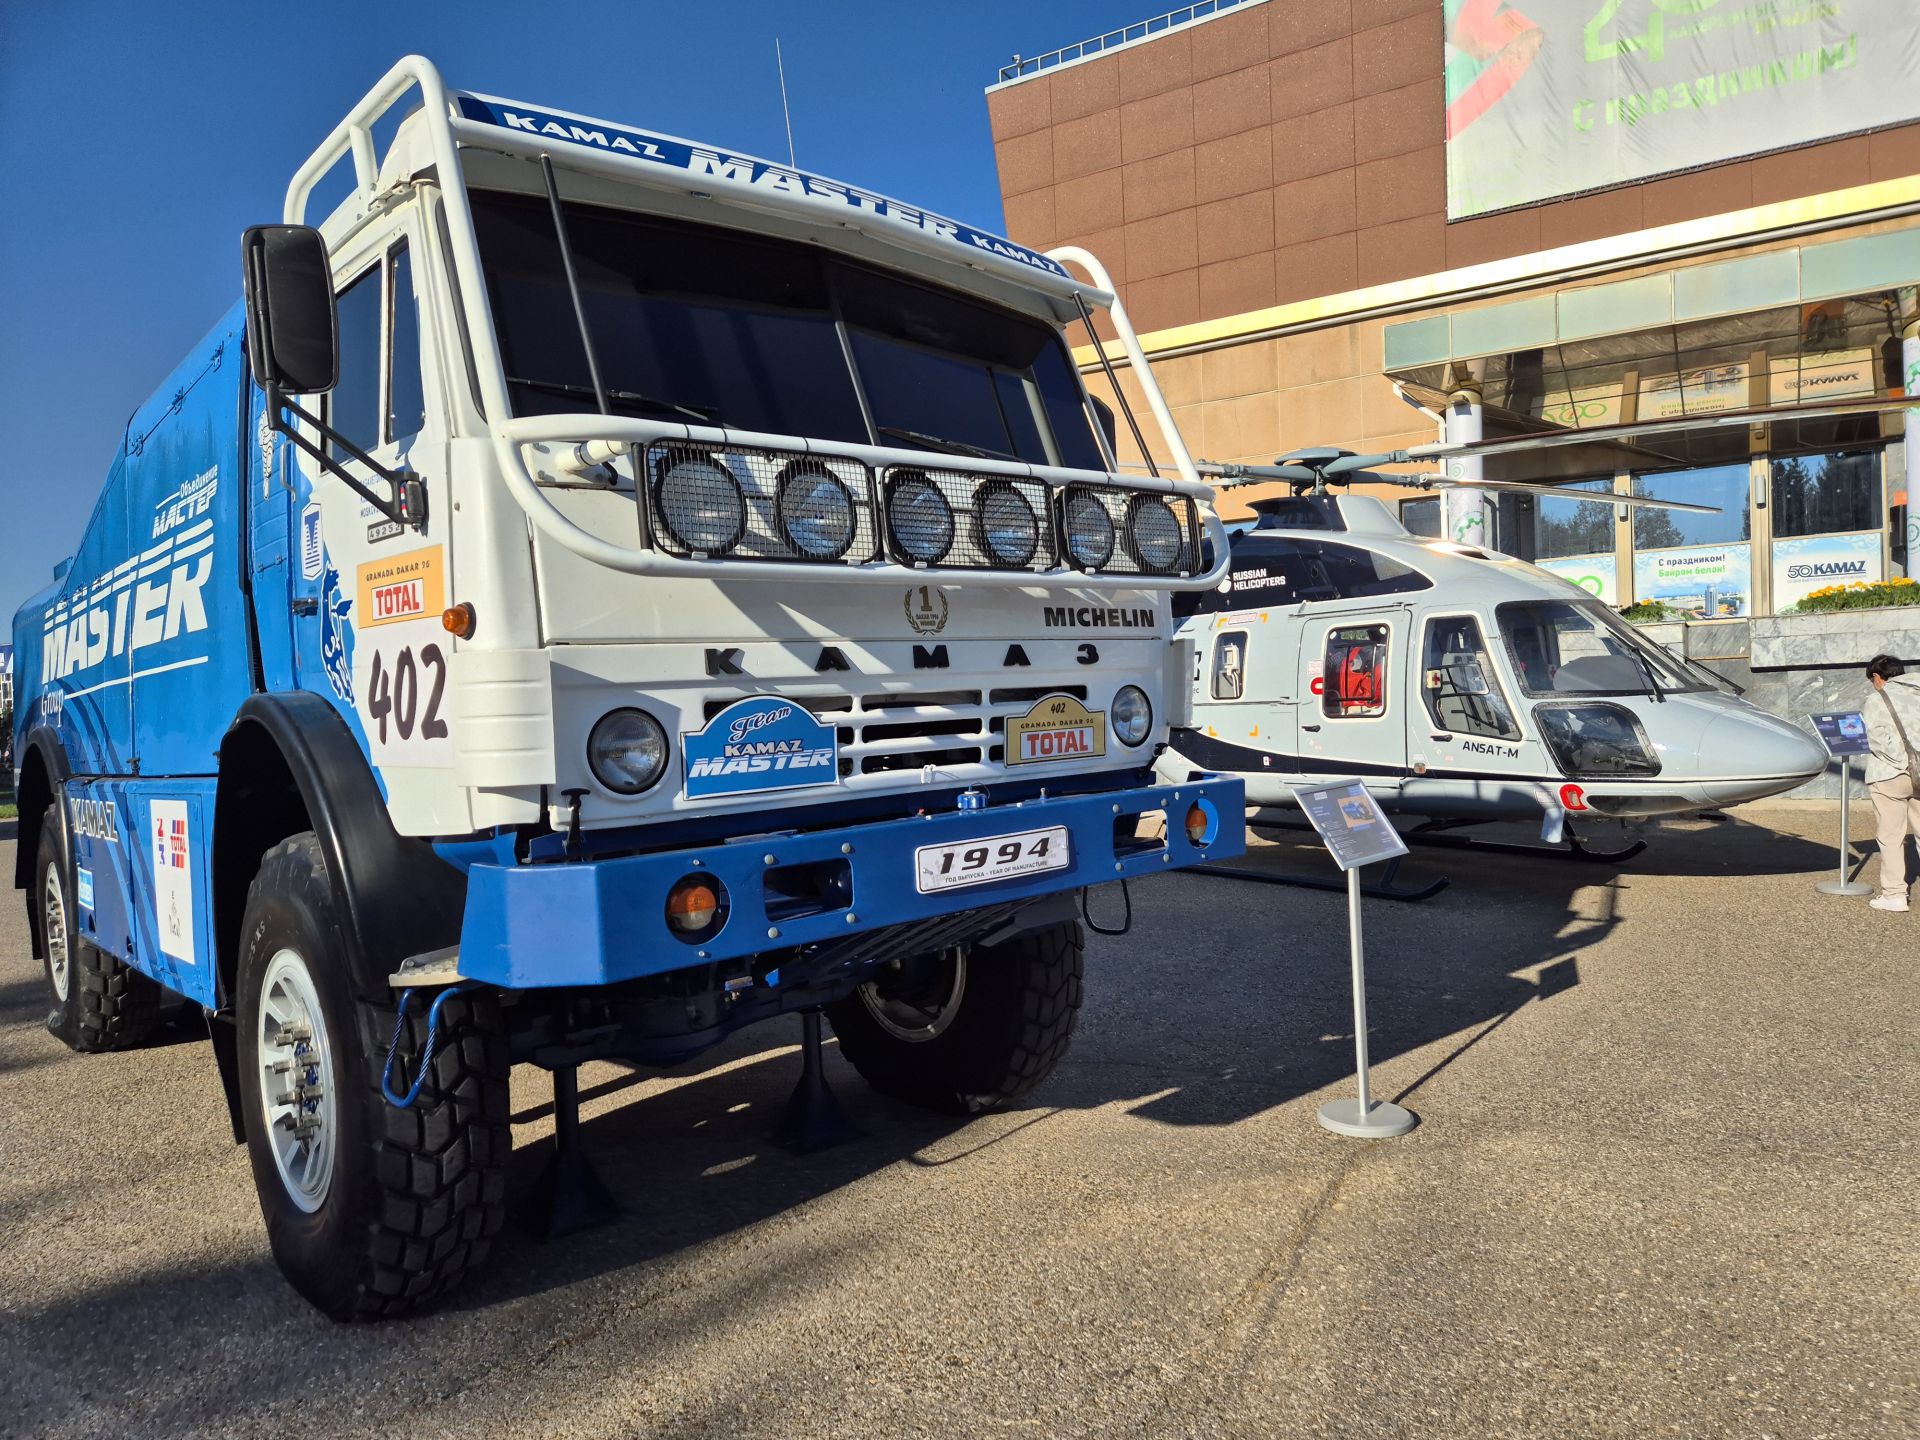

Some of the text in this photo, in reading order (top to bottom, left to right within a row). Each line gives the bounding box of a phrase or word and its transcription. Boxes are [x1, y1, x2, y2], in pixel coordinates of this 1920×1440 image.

[503, 112, 1063, 275] KAMAZ MASTER KAMAZ
[369, 522, 401, 540] 49252
[365, 559, 431, 582] GRANADA DAKAR 96
[1658, 553, 1726, 567] С праздником!
[1232, 568, 1267, 581] RUSSIAN
[1233, 576, 1286, 591] HELICOPTERS
[42, 519, 214, 685] MASTER
[375, 582, 420, 617] TOTAL
[918, 585, 933, 612] 1
[1044, 606, 1155, 628] MICHELIN
[368, 642, 449, 746] 402
[1050, 702, 1066, 714] 402
[728, 706, 792, 743] Team
[1020, 720, 1057, 729] GRANADA
[1059, 718, 1084, 726] DAKAR
[724, 738, 804, 758] KAMAZ
[1026, 729, 1089, 757] TOTAL
[1462, 741, 1519, 759] ANSAT-M
[688, 748, 834, 778] MASTER
[70, 797, 118, 843] KAMAZ
[170, 835, 186, 853] TOTAL
[940, 836, 1050, 875] 1994
[957, 872, 985, 881] ВЫПУСКА
[1012, 860, 1048, 872] MANUFACTURE
